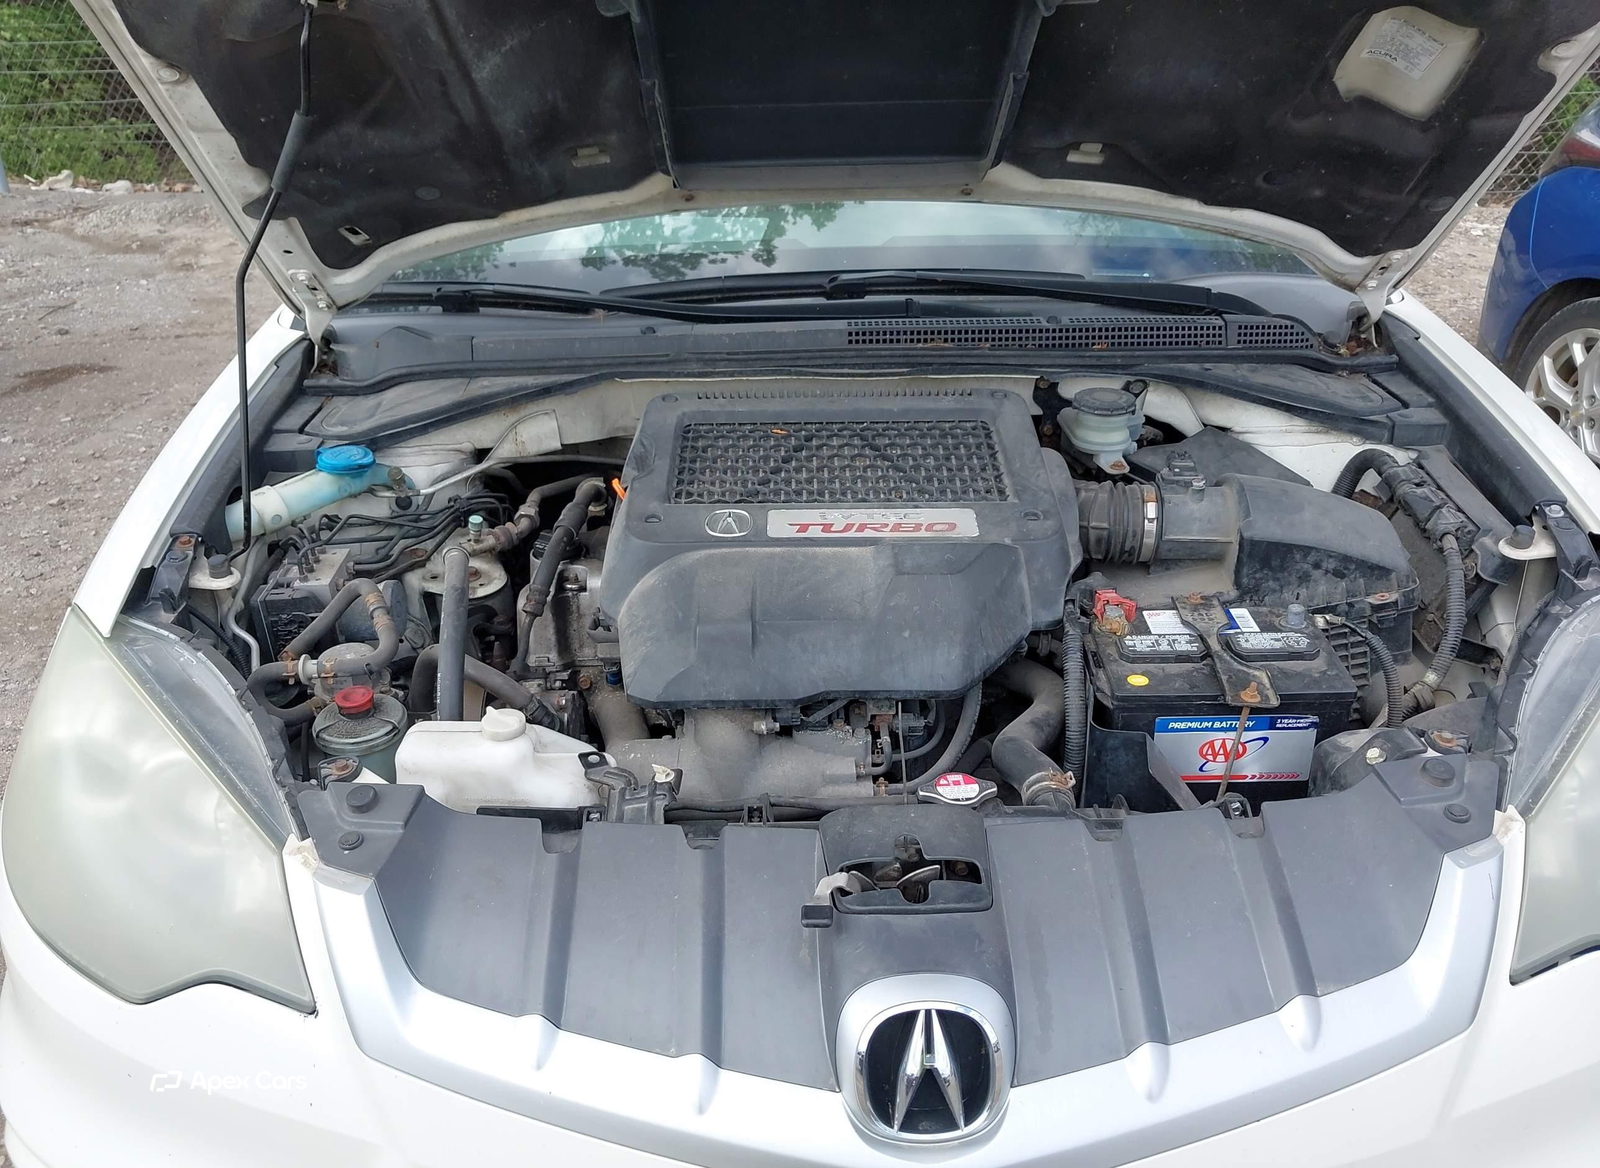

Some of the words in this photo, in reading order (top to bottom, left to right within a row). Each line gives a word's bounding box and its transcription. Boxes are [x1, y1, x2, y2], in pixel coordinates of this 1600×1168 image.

[1366, 49, 1398, 62] ACURA
[787, 522, 957, 534] TURBO
[1168, 721, 1212, 729] PREMIUM
[1213, 720, 1256, 728] BATTRY
